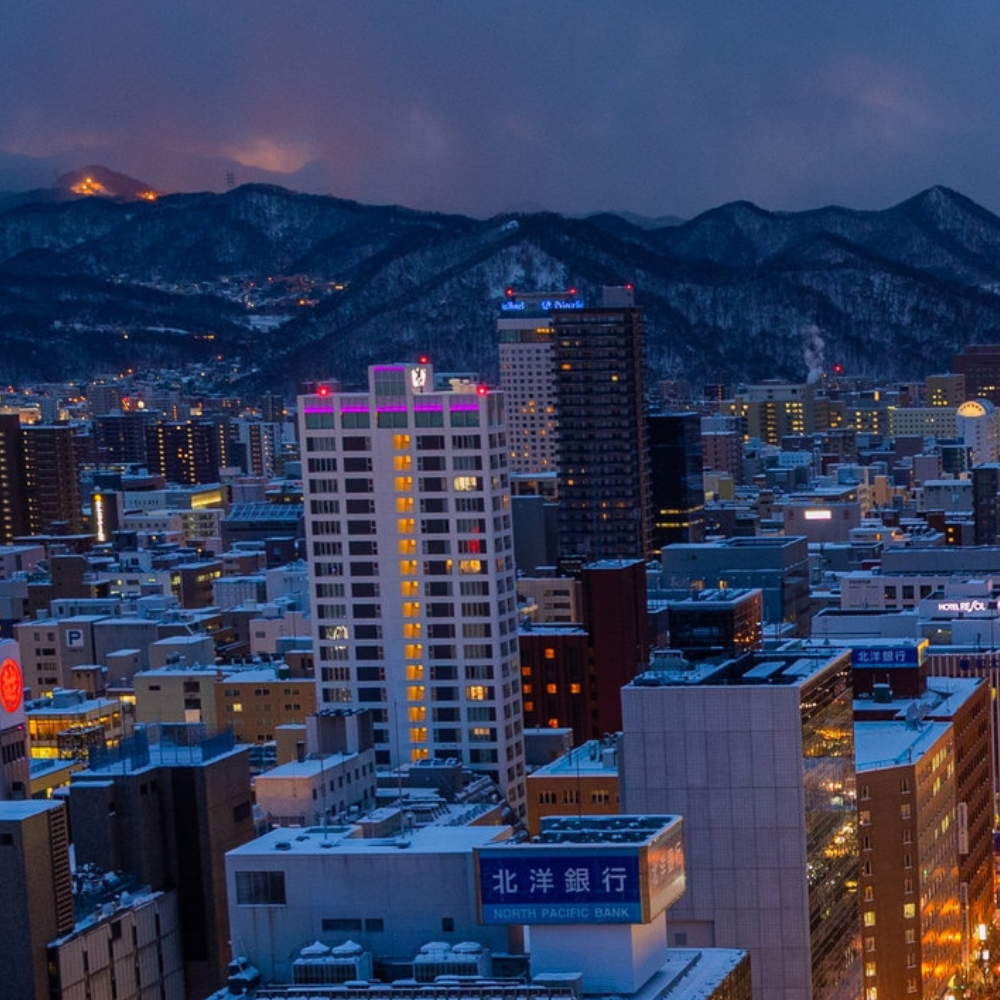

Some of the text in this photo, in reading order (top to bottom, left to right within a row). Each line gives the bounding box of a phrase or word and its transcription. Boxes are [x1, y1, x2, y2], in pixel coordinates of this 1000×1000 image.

[938, 603, 960, 612] HOTEL
[68, 630, 81, 646] P
[857, 650, 906, 662] 北洋銀行
[492, 867, 628, 894] 北洋銀行
[493, 907, 629, 919] NORTH PACIFIC BANK
